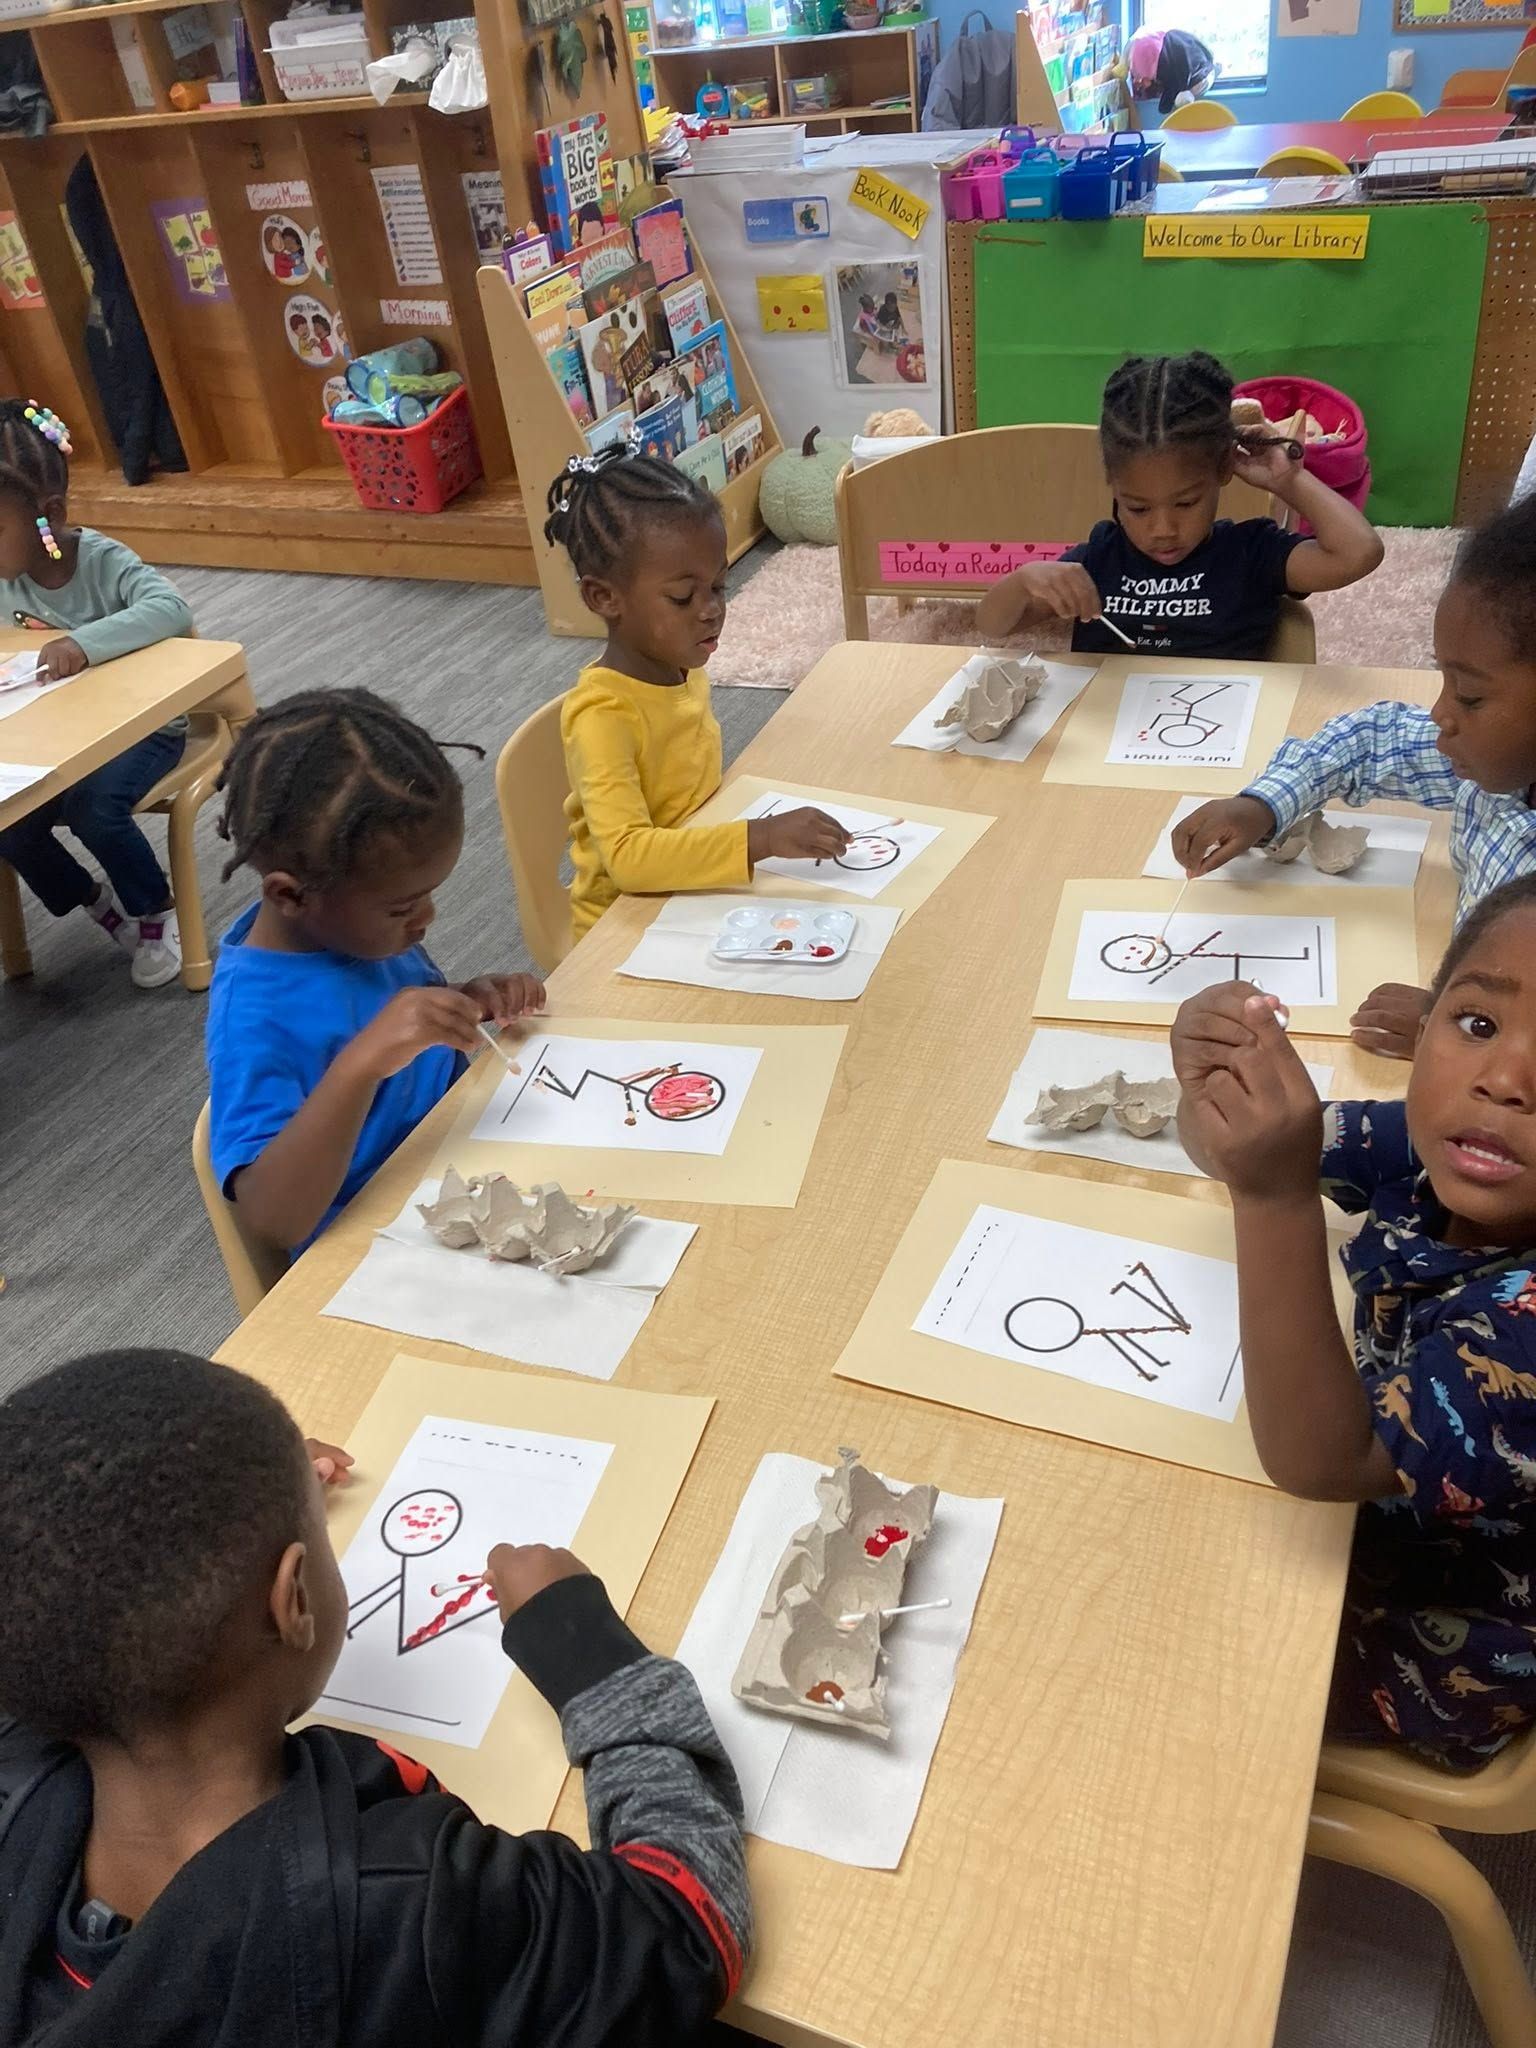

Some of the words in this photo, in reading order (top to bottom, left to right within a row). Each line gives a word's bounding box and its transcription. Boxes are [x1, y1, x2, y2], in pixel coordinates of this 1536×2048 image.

[564, 139, 576, 152] my
[576, 131, 593, 147] first
[566, 146, 596, 180] BIG
[468, 179, 502, 189] Meanin
[570, 179, 588, 194] book
[589, 173, 598, 185] of
[574, 187, 597, 205] words
[747, 217, 770, 226] Books
[1149, 223, 1223, 247] Welcome
[1226, 224, 1247, 247] to
[1252, 224, 1286, 247] Our
[1293, 223, 1363, 254] Library
[387, 302, 441, 320] Morning
[787, 317, 797, 328] 2
[888, 551, 948, 577] Today
[955, 561, 968, 574] a
[1120, 572, 1206, 596] TOMMY
[1103, 595, 1213, 617] HILFIGER
